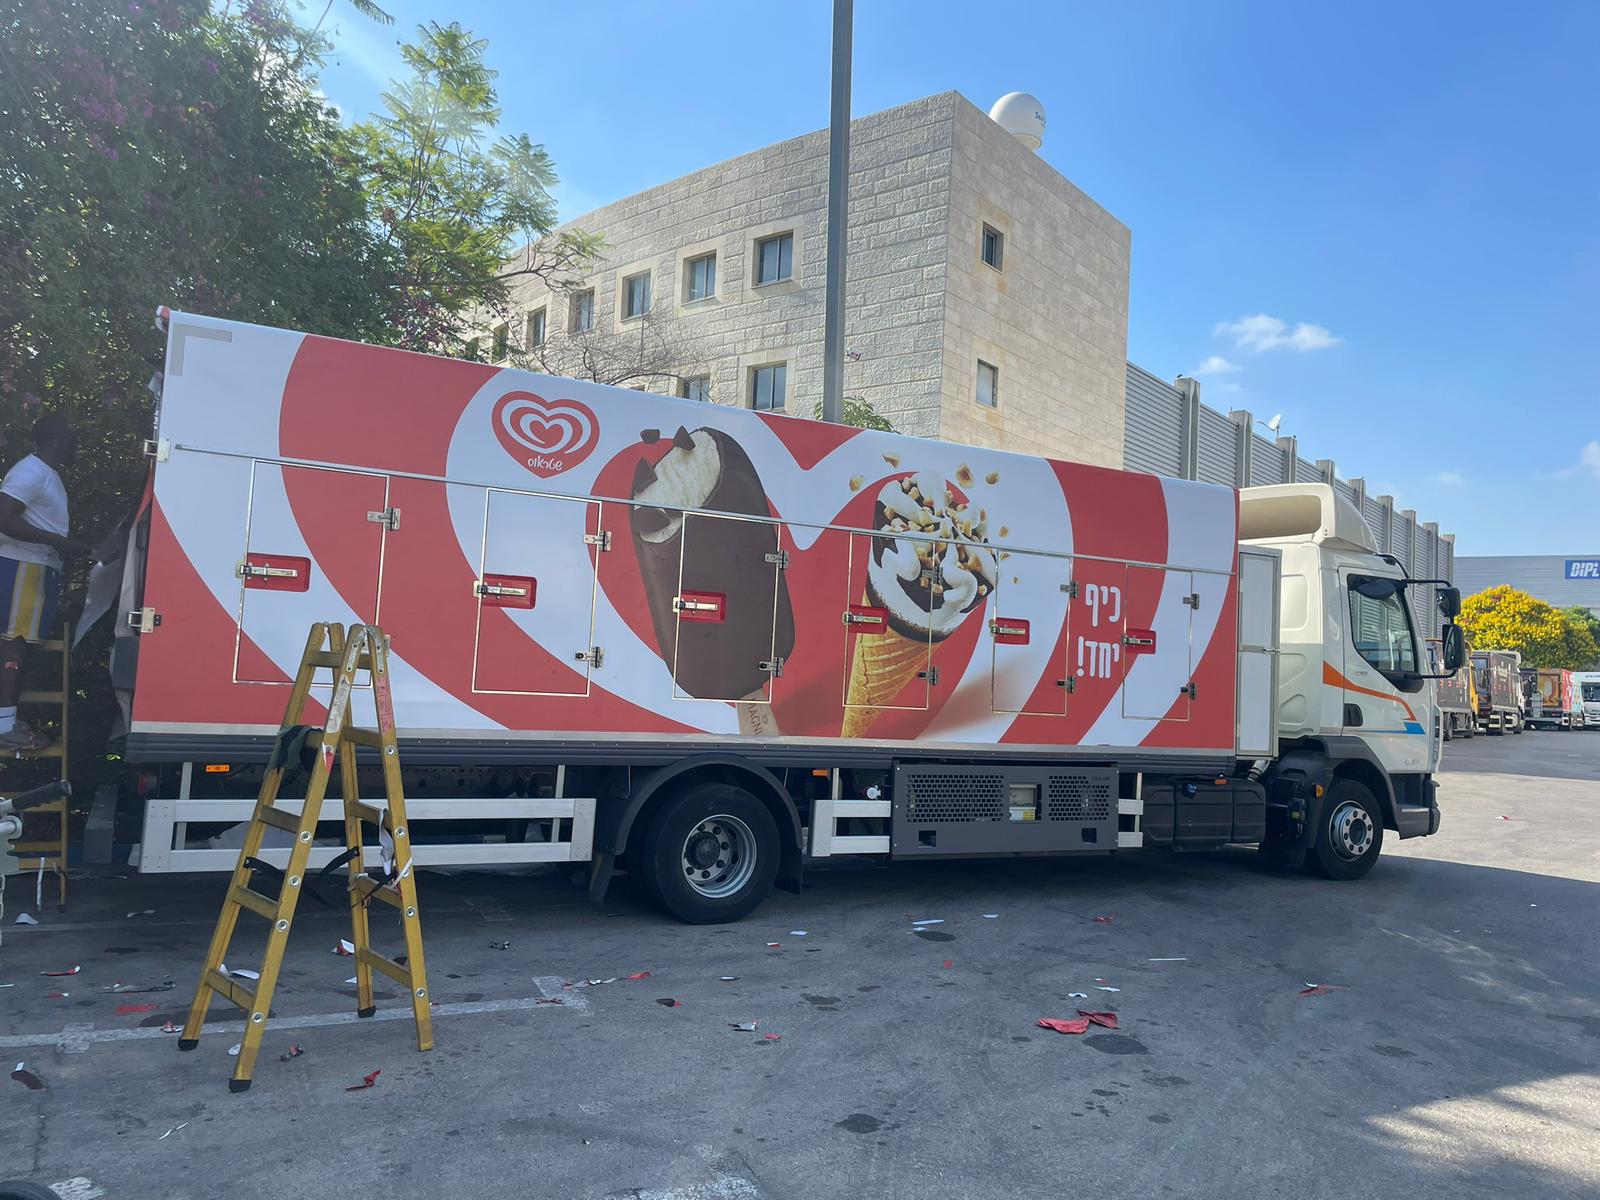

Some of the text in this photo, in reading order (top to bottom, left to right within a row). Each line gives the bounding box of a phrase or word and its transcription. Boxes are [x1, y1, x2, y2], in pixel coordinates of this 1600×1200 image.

[527, 455, 563, 471] שטראוס
[1085, 583, 1121, 627] כיף
[1076, 635, 1120, 679] יחד!
